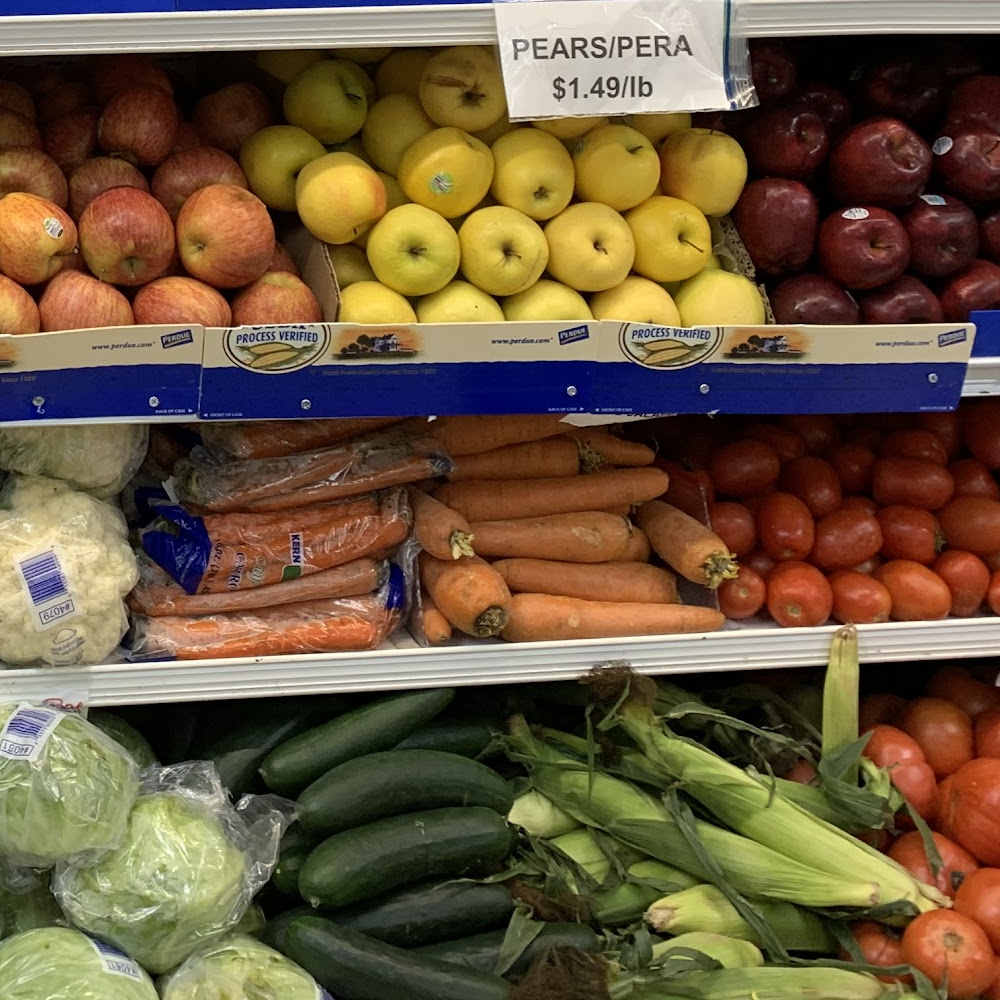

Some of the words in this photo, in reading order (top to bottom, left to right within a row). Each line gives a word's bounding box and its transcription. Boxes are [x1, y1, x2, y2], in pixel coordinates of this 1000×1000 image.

[512, 34, 693, 60] PEARS/PERA
[552, 75, 654, 102] $1.49/lb
[162, 331, 190, 344] PERDUE
[236, 331, 276, 344] PROCESS
[279, 331, 319, 343] VERIFIED
[632, 327, 671, 340] PROCESS
[673, 328, 711, 340] VERIFIED
[290, 534, 301, 564] KERN
[43, 602, 71, 621] #4079
